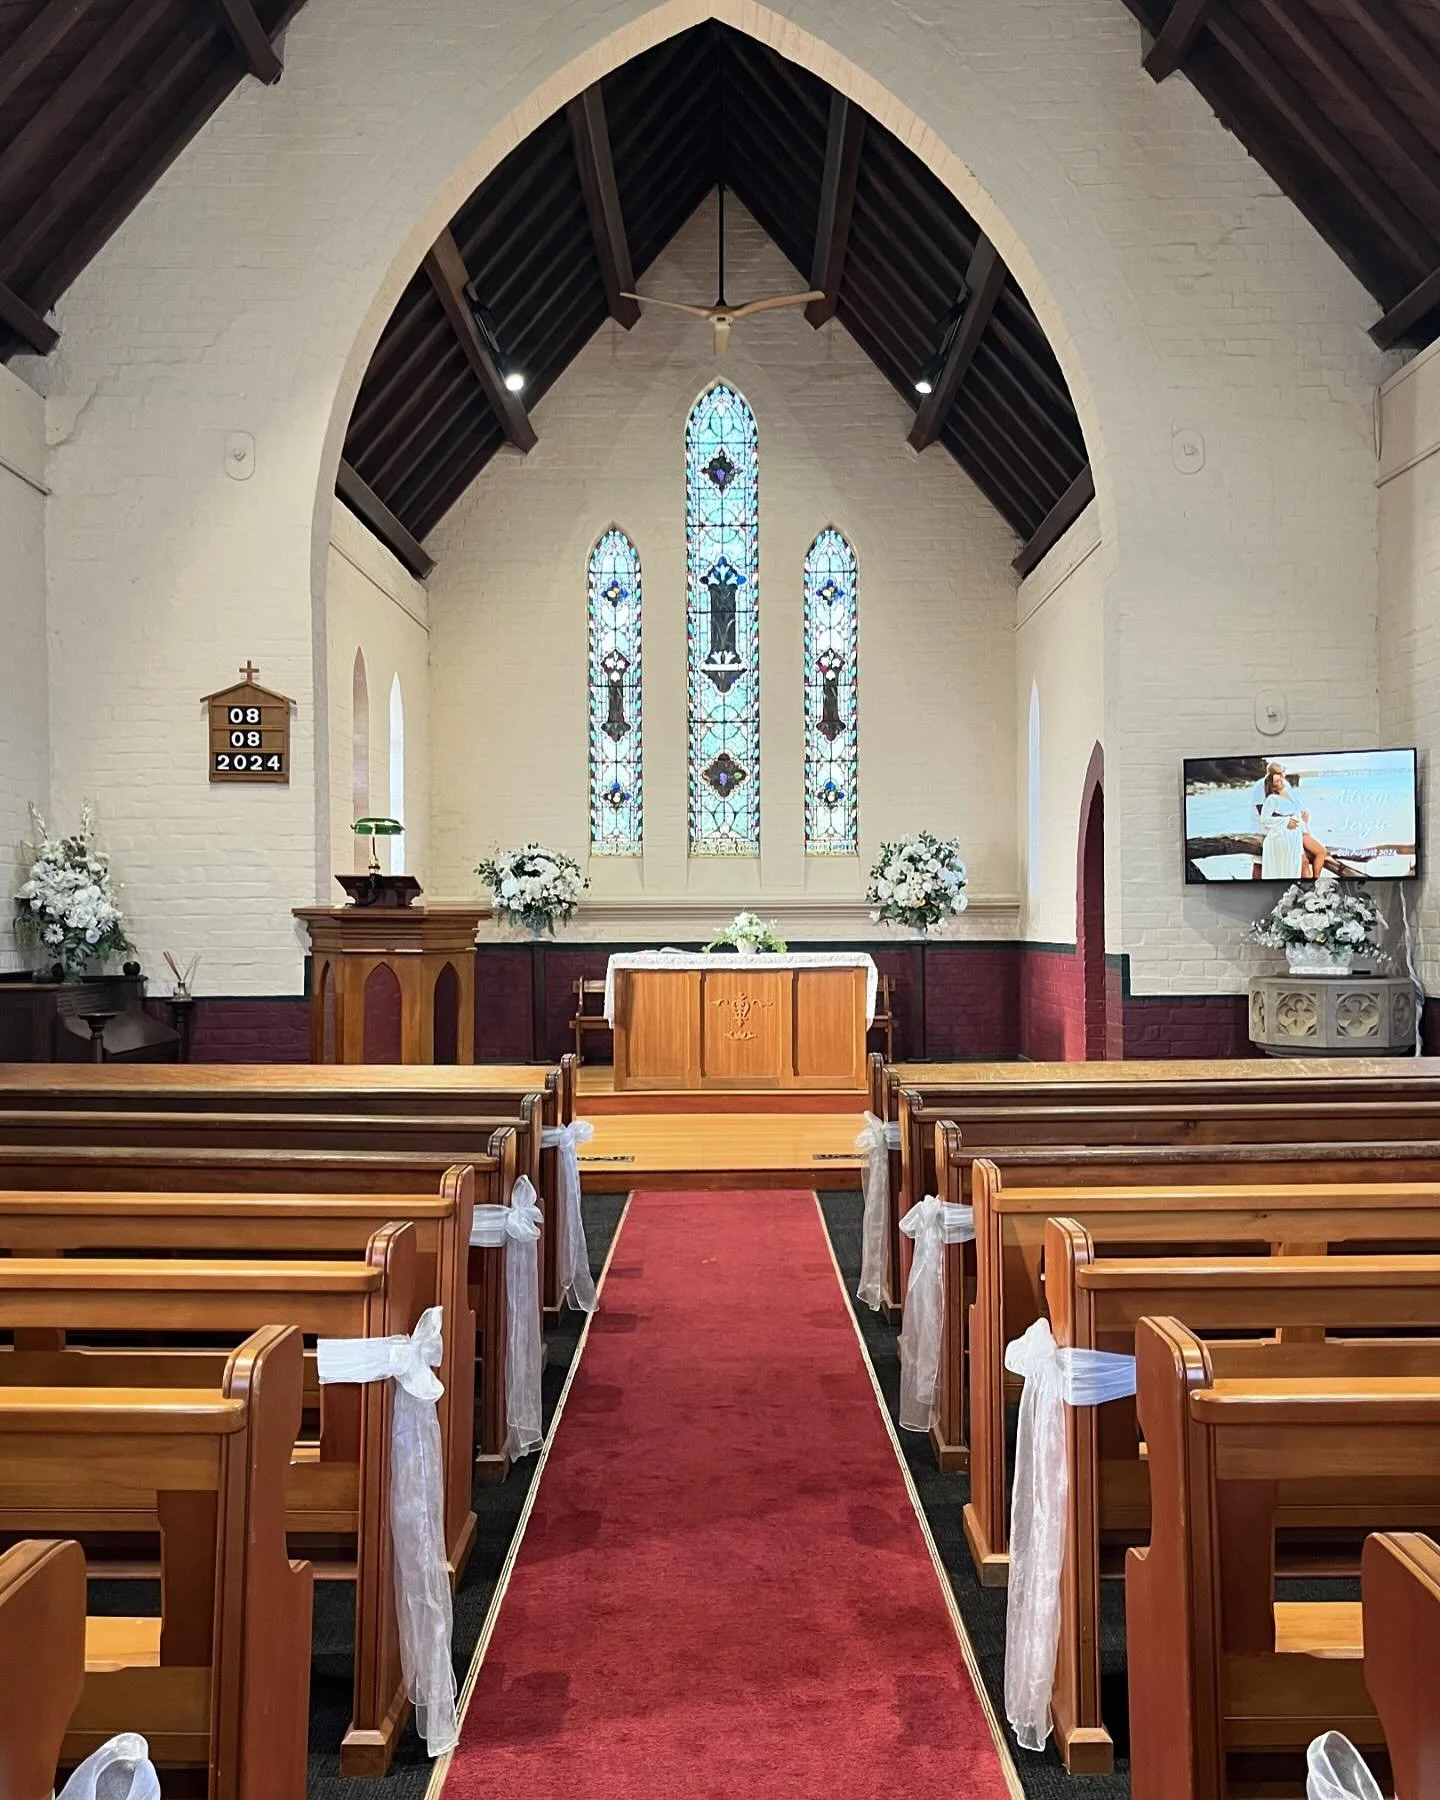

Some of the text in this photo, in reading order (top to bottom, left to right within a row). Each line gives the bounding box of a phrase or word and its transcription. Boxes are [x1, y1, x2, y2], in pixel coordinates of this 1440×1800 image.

[230, 708, 260, 724] 08
[231, 731, 260, 747] 08
[217, 755, 280, 771] 2024
[1350, 847, 1377, 858] August
